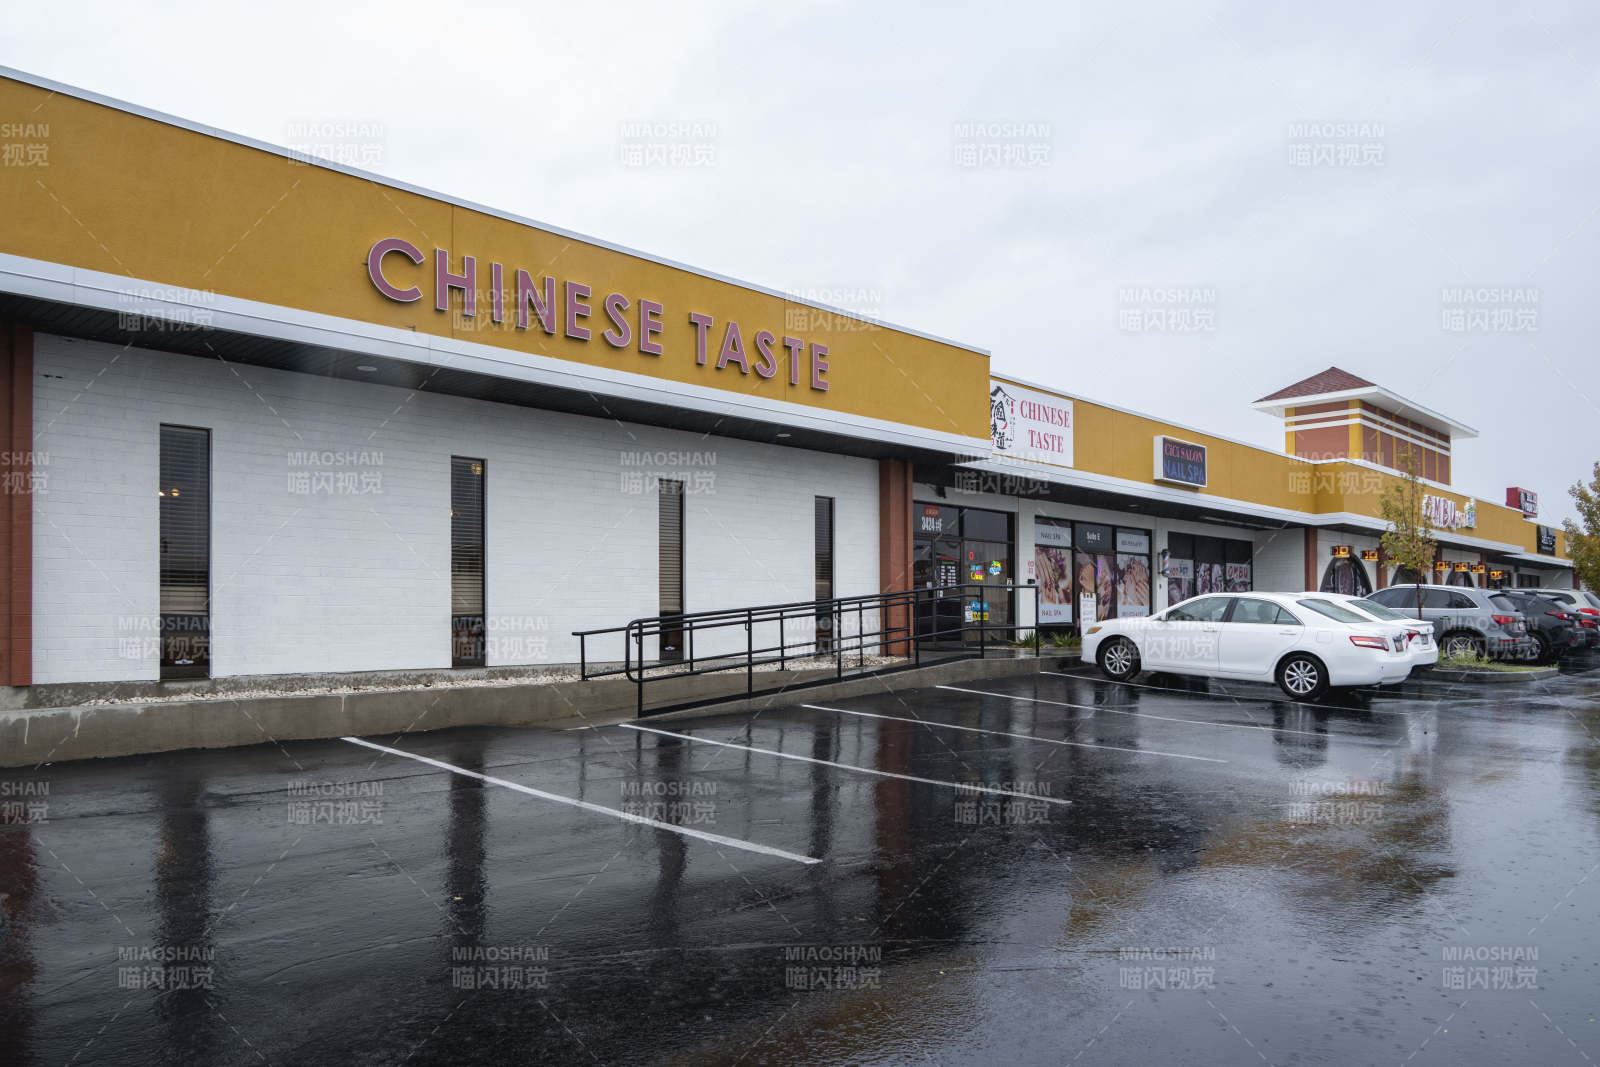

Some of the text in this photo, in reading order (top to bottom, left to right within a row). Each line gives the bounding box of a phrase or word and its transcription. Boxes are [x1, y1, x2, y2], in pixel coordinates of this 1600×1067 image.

[367, 237, 832, 393] CHINESE TASTE
[1020, 399, 1071, 428] CHINESE
[1028, 429, 1064, 454] TASTE
[1164, 459, 1205, 483] NAIL SPA
